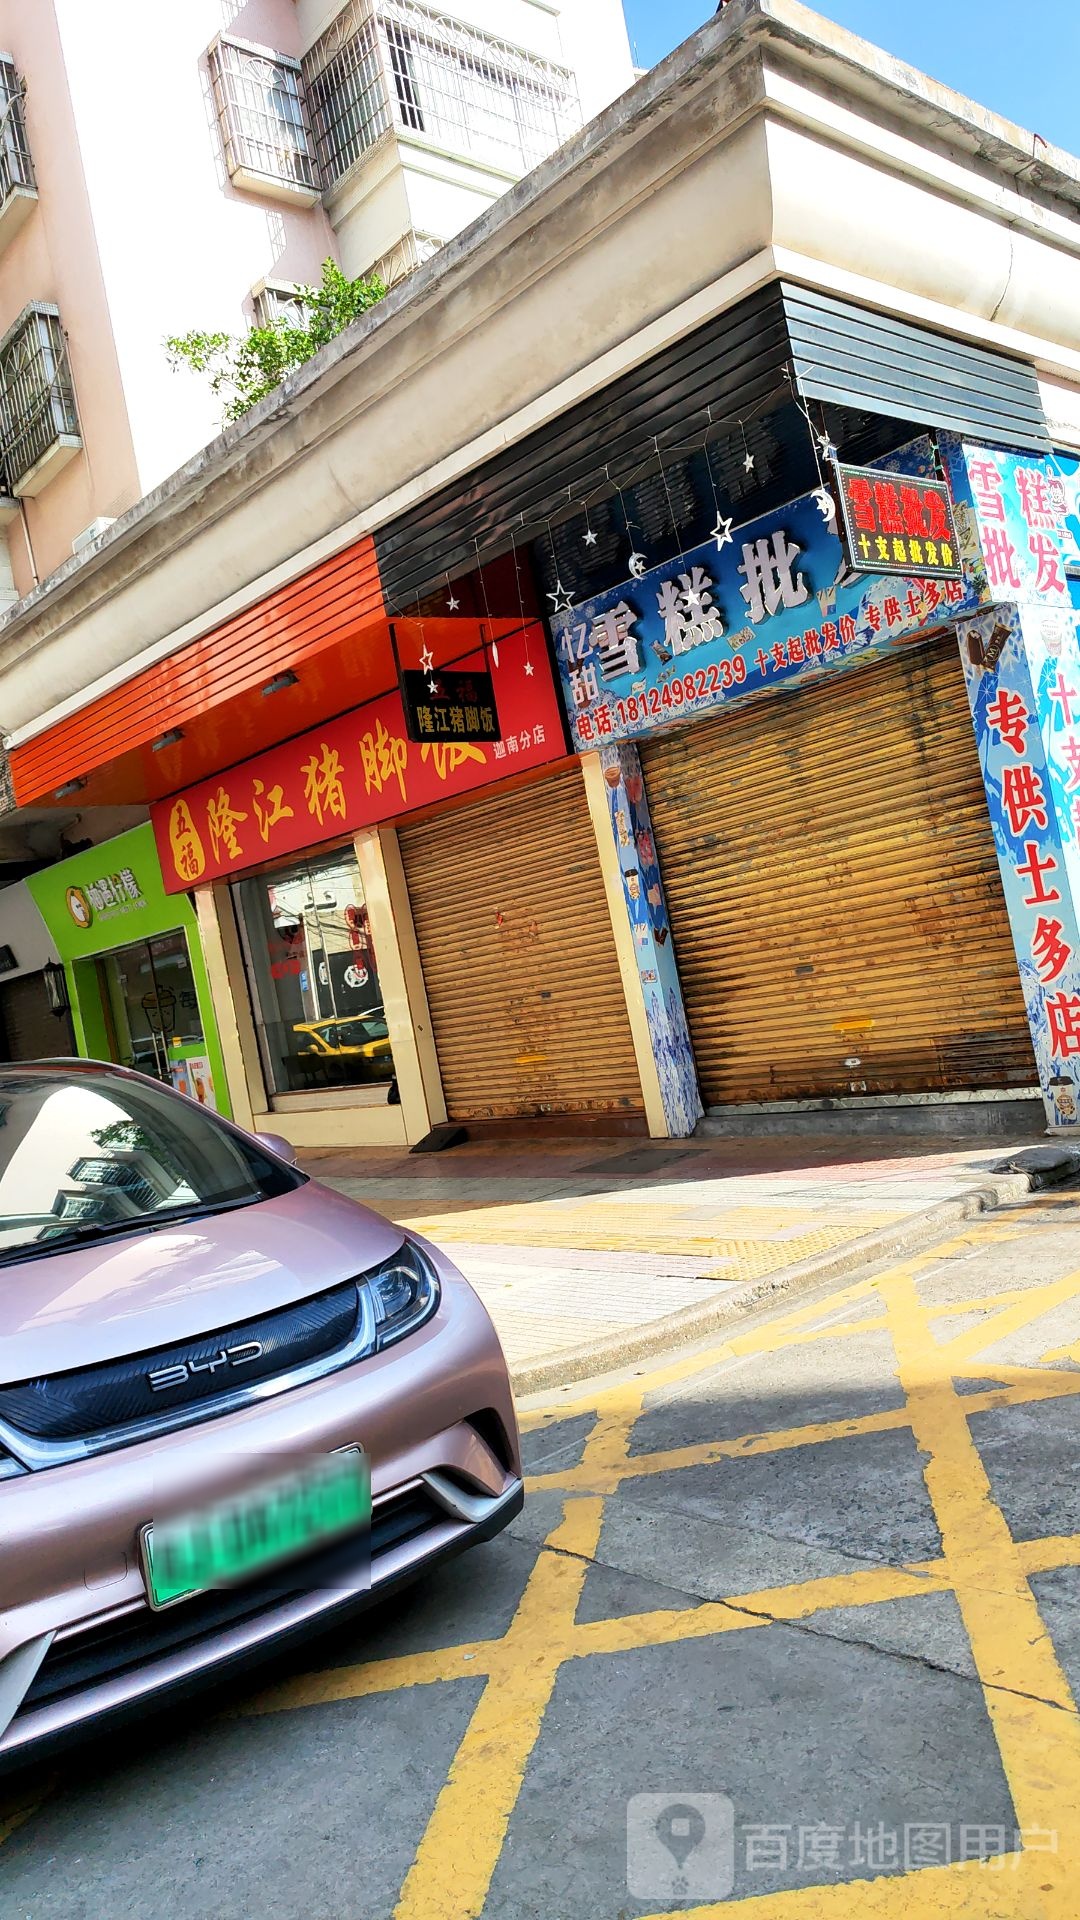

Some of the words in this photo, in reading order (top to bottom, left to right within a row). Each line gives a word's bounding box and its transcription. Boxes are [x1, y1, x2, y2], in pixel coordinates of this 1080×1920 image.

[848, 479, 951, 541] 雪糕批发
[969, 460, 1056, 529] 雪糕
[858, 533, 953, 567] 十支起批发价
[982, 525, 1066, 593] 批发
[588, 526, 858, 684] 雪糕批
[560, 623, 600, 706] 忆甜
[754, 614, 857, 677] 十支起批发价
[416, 705, 496, 734] 隆江猪脚饭
[175, 804, 200, 876] 五福
[988, 690, 1080, 1057] 专供士多店
[149, 1341, 263, 1392] BYD
